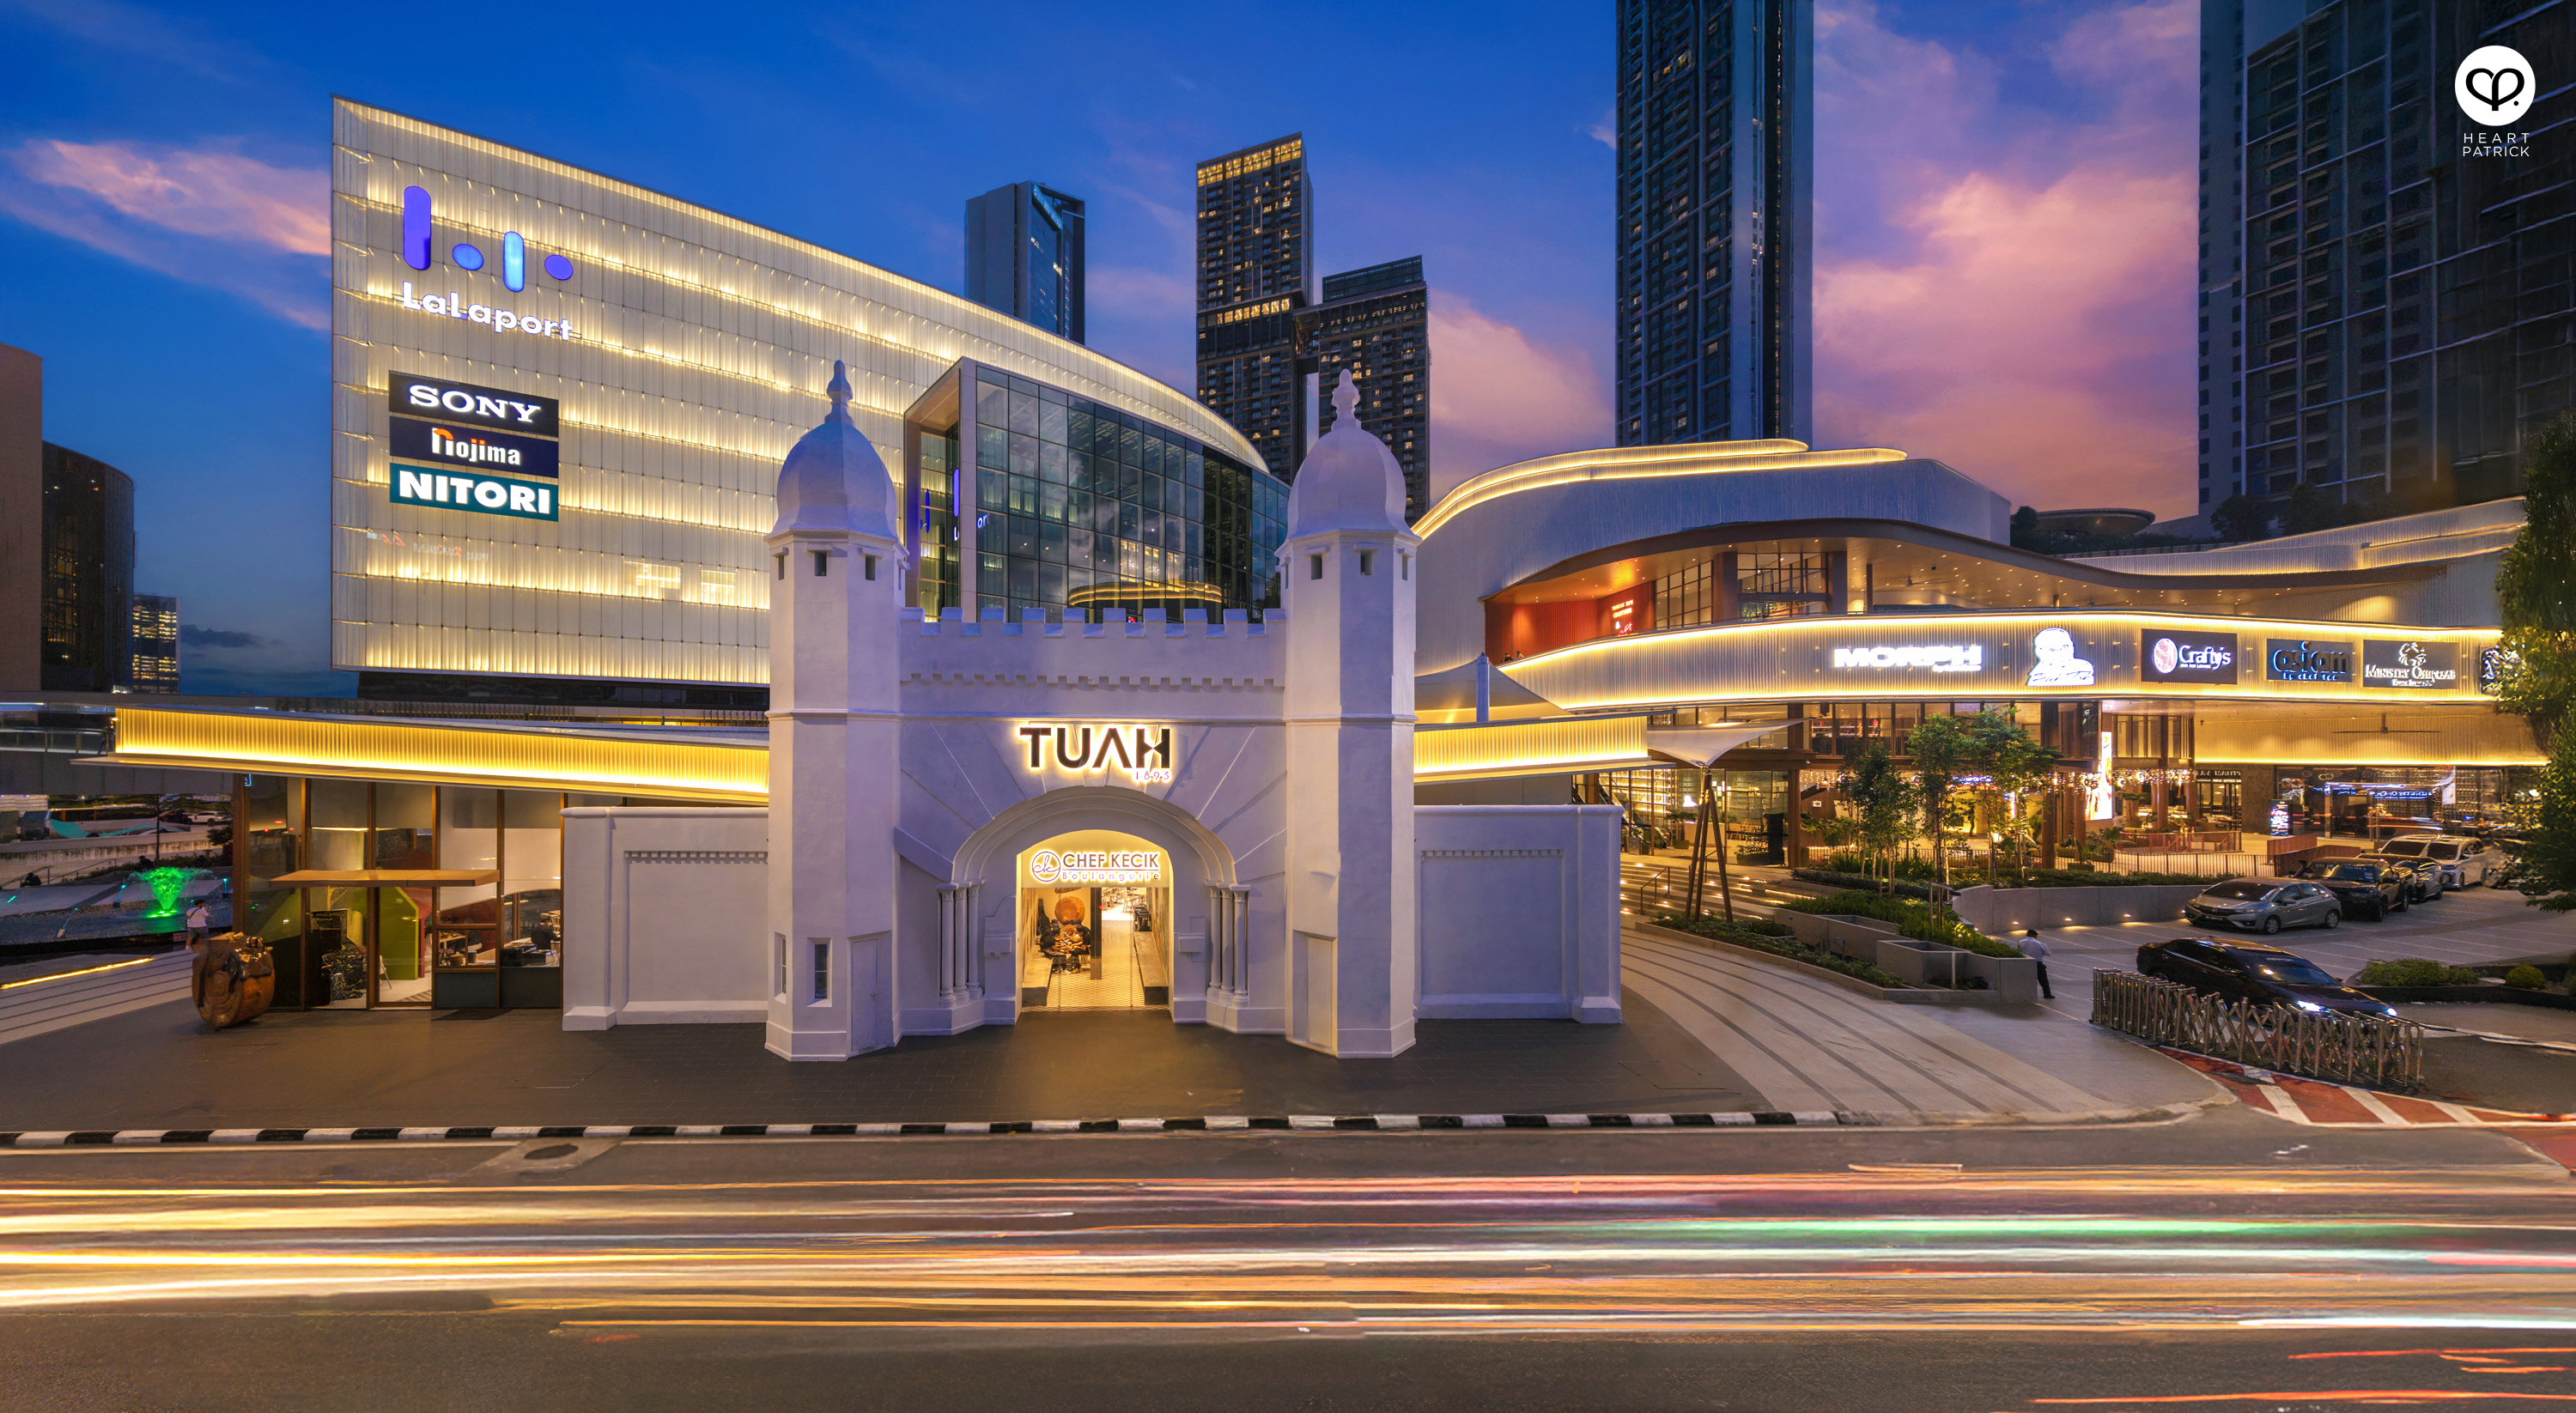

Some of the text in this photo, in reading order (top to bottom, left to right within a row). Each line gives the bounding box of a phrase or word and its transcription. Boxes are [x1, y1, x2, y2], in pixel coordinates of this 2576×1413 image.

[402, 280, 573, 341] LaLaport
[409, 385, 541, 423] SONY
[431, 427, 521, 465] nojima
[398, 470, 550, 515] NITORI
[1834, 645, 1983, 668] MORPH
[2178, 644, 2233, 670] Crafty's
[1019, 726, 1171, 769] TUAH
[1062, 853, 1105, 868] CHEF
[1111, 853, 1159, 868] KECIK
[1062, 872, 1159, 882] Boulangerie
